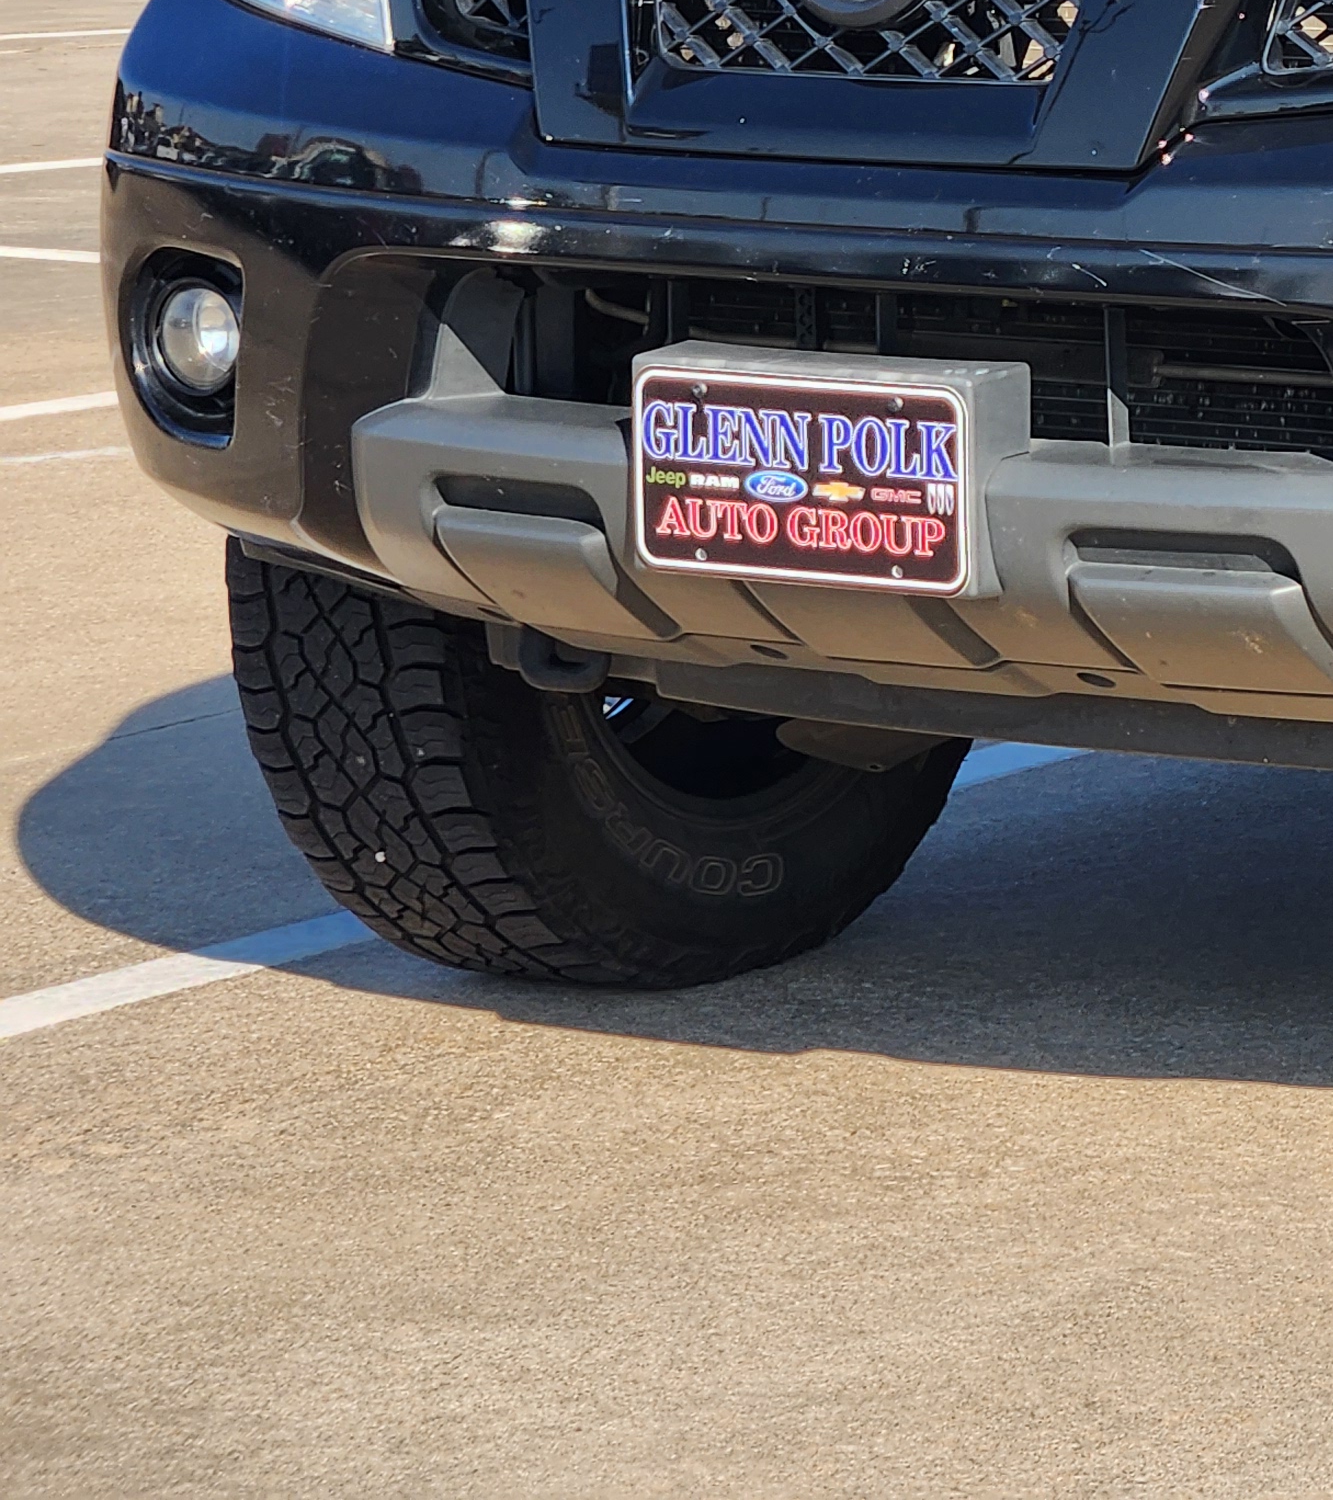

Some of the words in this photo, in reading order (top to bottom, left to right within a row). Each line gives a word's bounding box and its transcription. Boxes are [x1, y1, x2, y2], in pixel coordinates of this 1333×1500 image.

[642, 399, 808, 470] GLENN
[818, 414, 958, 482] POLK
[646, 466, 687, 489] Jeep
[690, 474, 740, 489] RAM
[755, 476, 797, 498] Ford
[869, 488, 922, 505] GMC
[656, 496, 778, 544] AUTO
[787, 506, 946, 557] GROUP
[549, 703, 784, 896] COURSE
